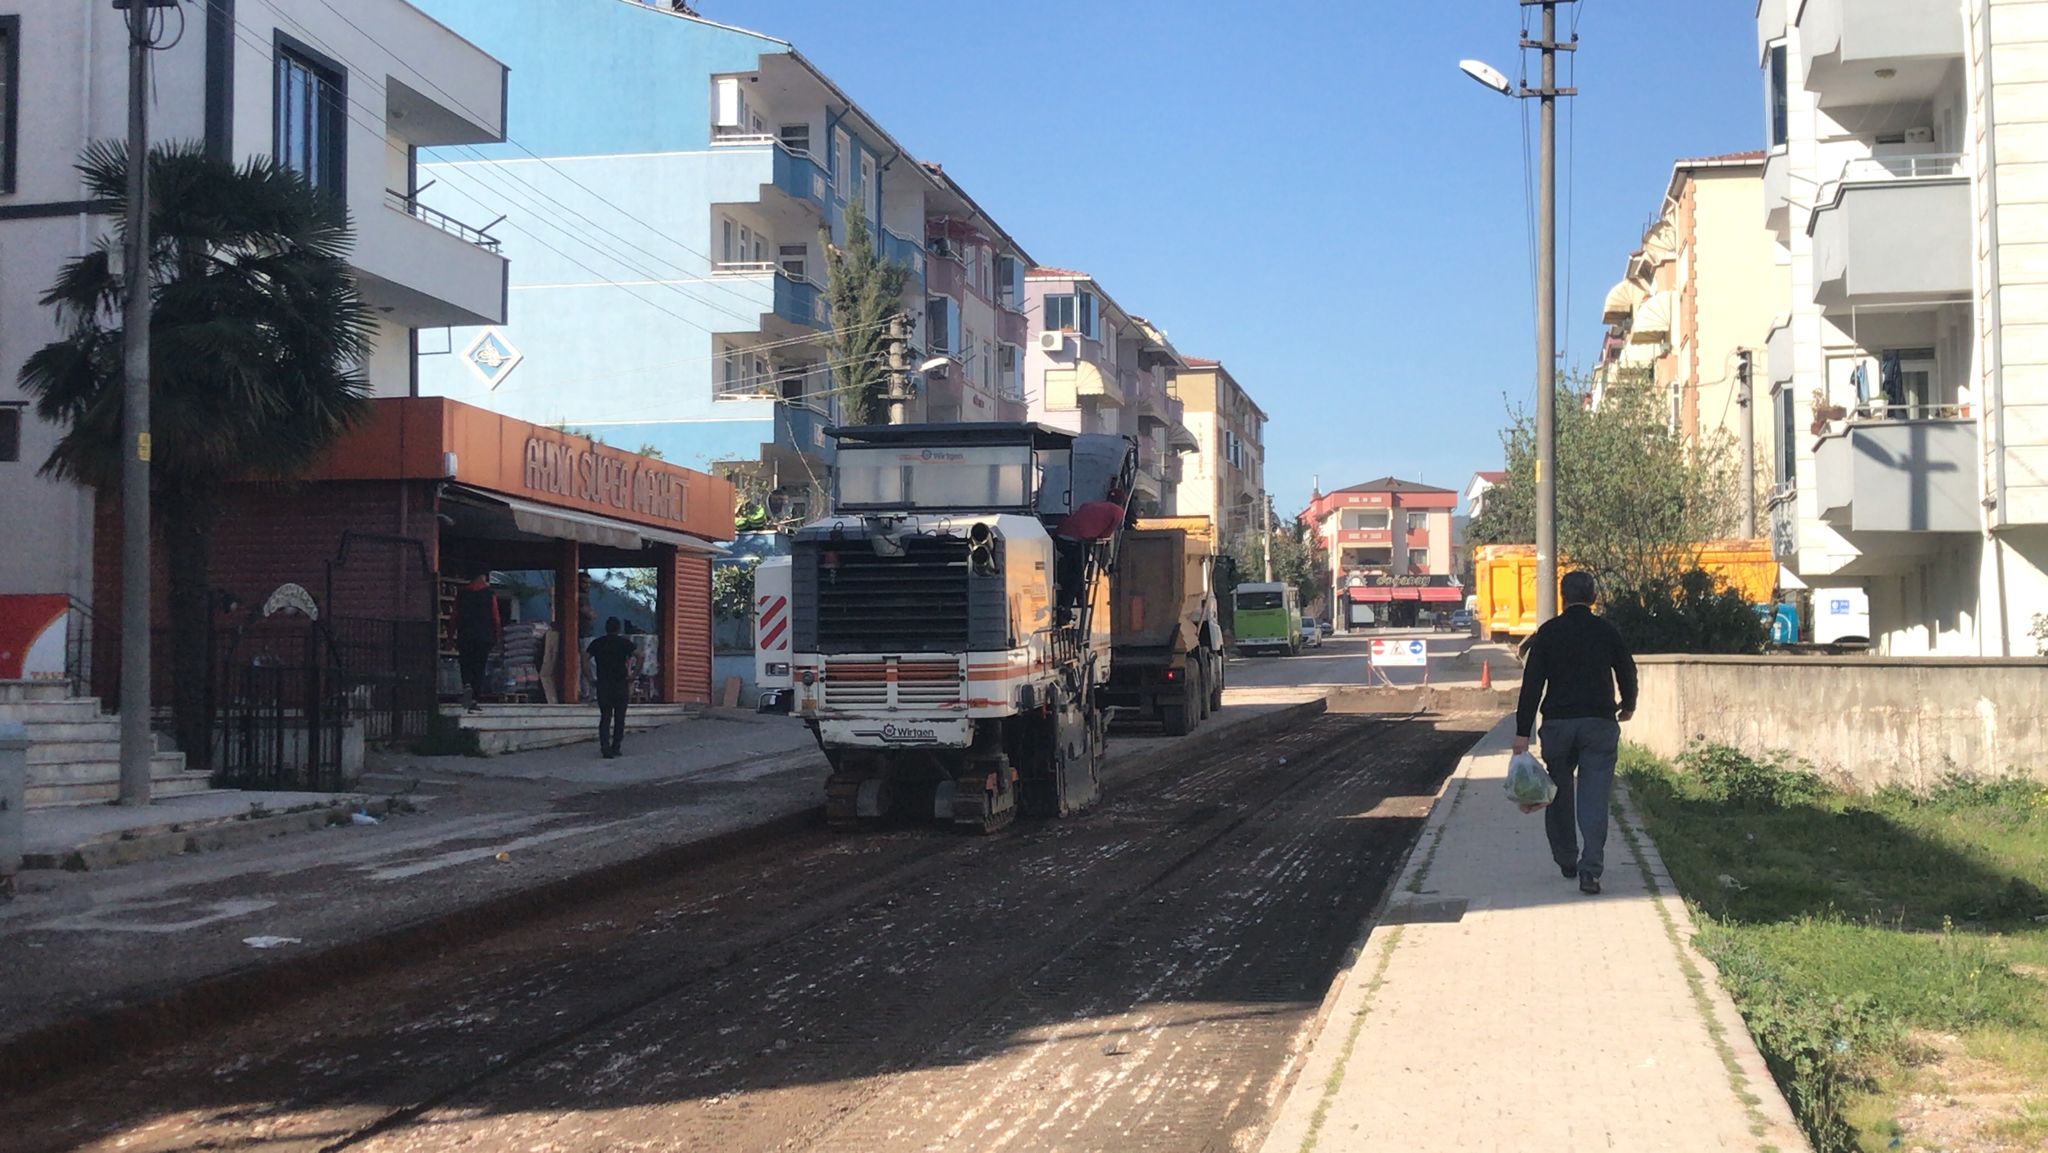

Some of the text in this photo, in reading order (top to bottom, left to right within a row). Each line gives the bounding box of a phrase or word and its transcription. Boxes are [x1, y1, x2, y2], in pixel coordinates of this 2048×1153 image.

[933, 452, 964, 462] Wirtgen
[525, 437, 576, 497] AYDIN
[632, 461, 690, 522] MARKET
[897, 727, 934, 738] Wirtgen
